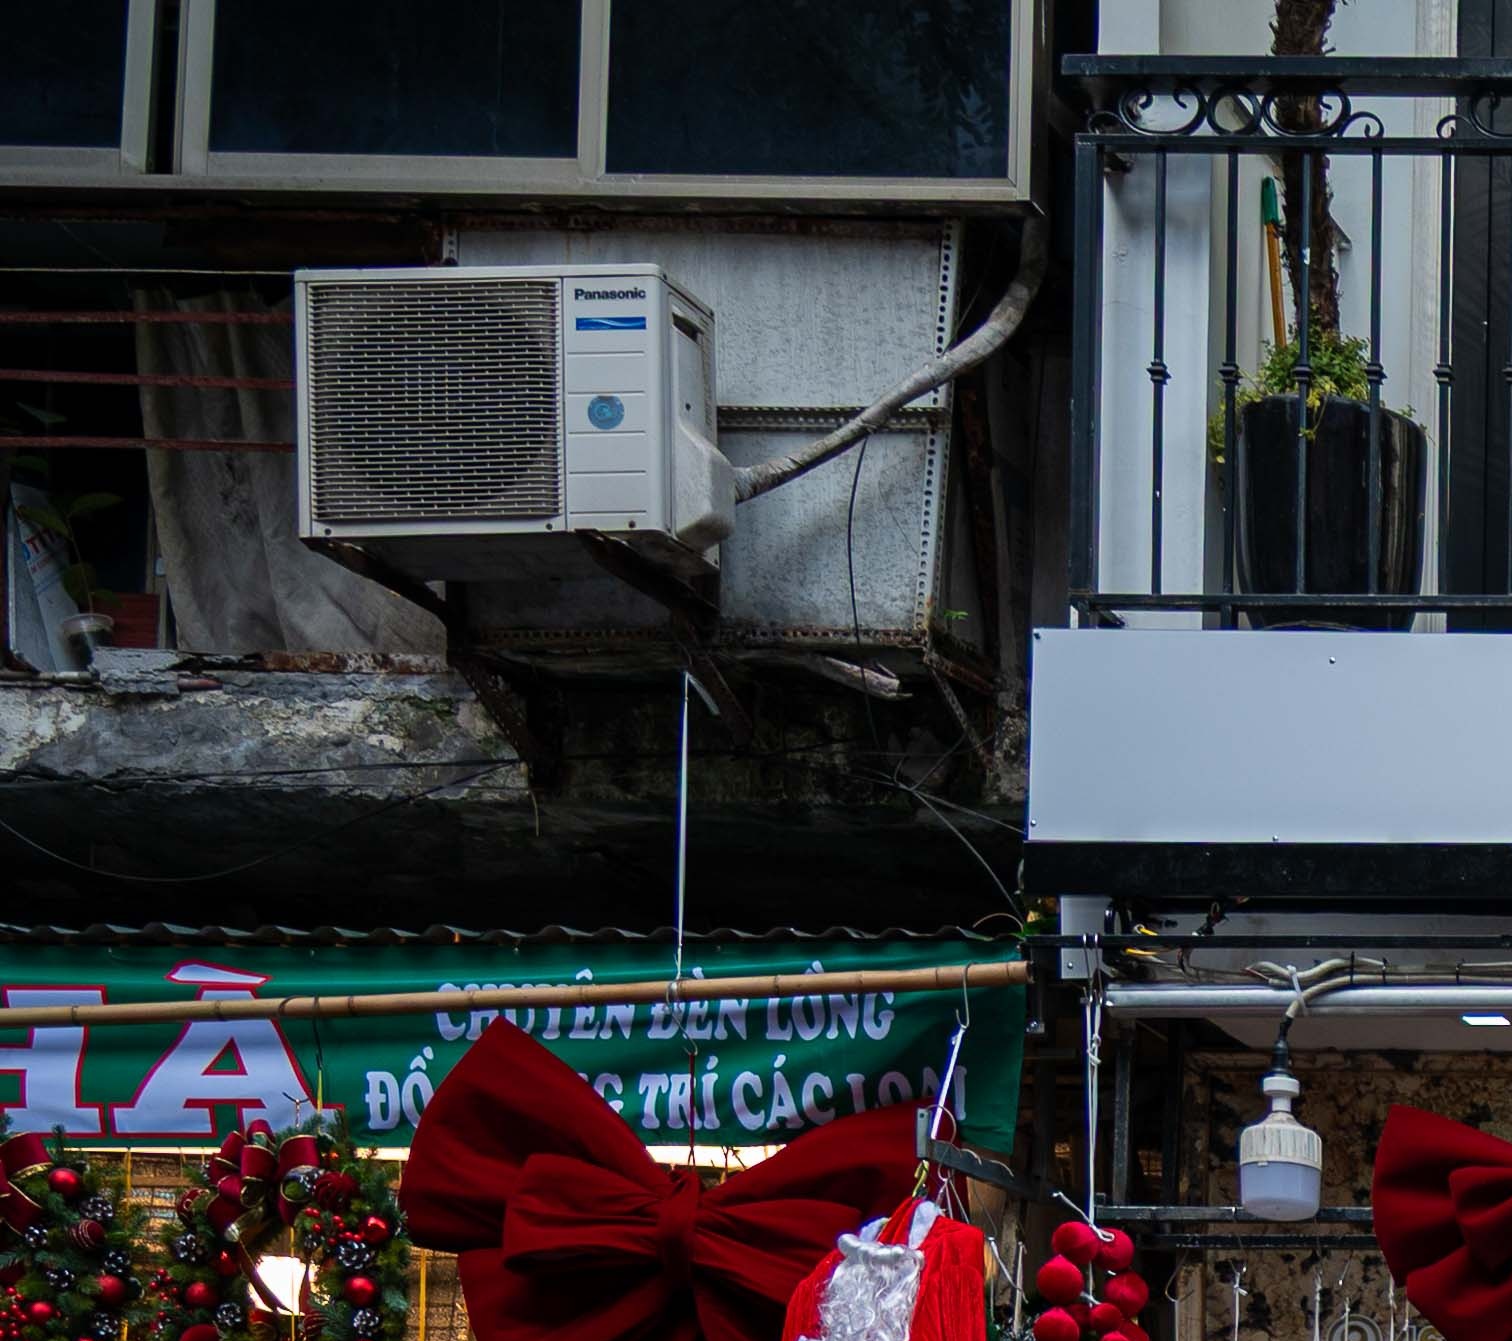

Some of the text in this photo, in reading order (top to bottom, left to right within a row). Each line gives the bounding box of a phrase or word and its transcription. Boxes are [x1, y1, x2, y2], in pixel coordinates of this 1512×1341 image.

[574, 287, 647, 300] Panasonic
[638, 1055, 721, 1129] TRÍ
[731, 1054, 835, 1129] CÁC
